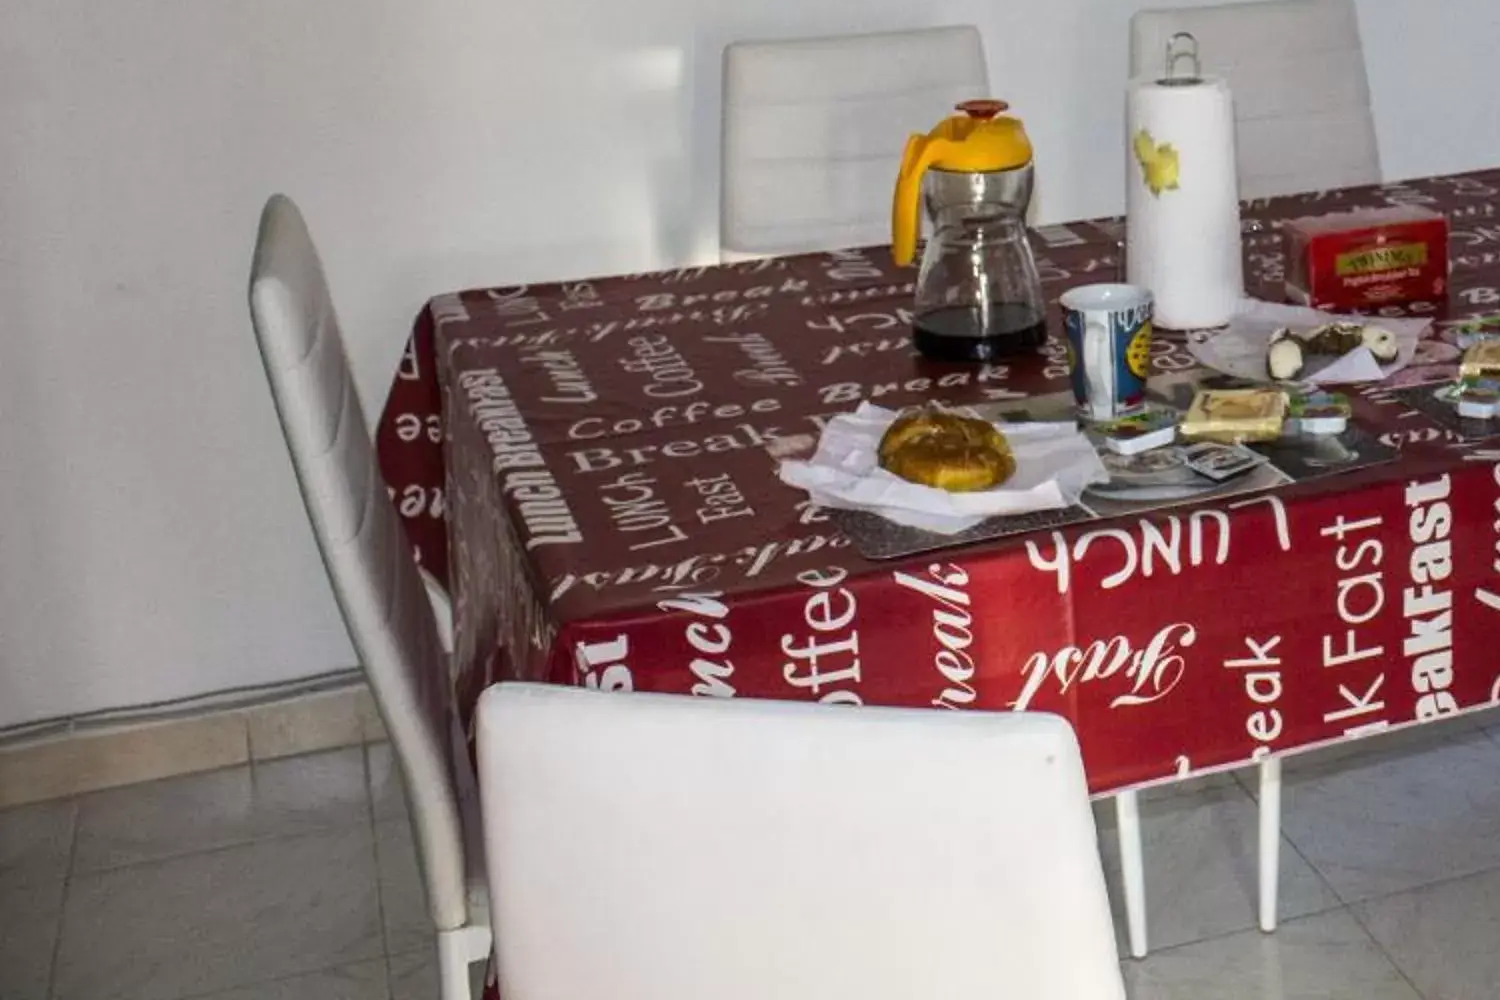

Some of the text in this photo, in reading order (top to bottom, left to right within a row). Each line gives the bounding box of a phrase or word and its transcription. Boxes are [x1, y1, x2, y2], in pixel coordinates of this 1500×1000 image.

[617, 334, 704, 398] Coffee
[565, 396, 783, 441] Coffee
[565, 424, 784, 475] Break
[505, 471, 584, 551] Lunch
[683, 472, 756, 524] Fast
[1006, 621, 1197, 713] Fast
